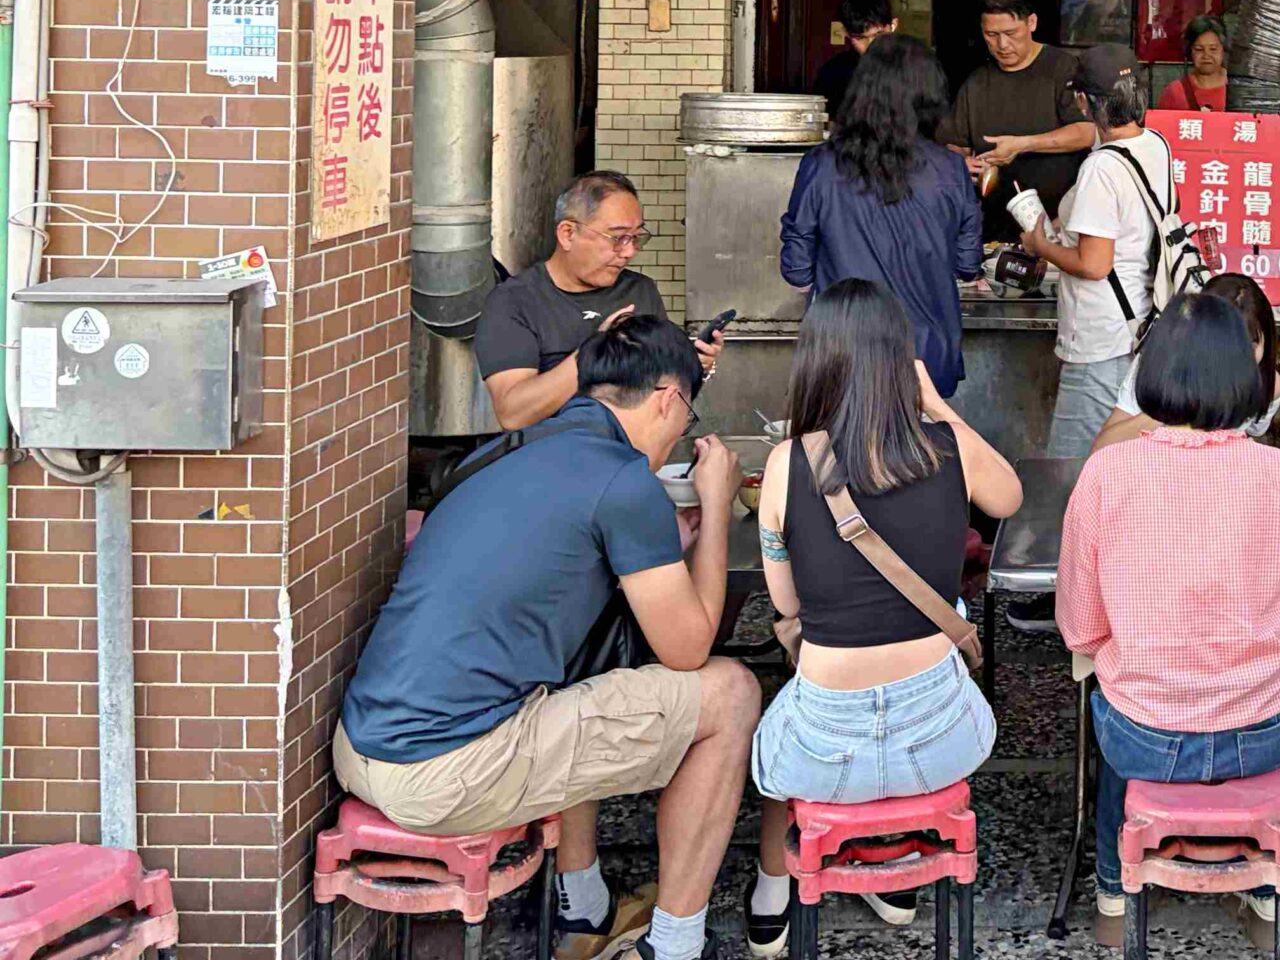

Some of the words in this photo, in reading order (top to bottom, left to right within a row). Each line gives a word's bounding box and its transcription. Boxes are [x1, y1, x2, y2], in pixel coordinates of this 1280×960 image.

[1242, 161, 1273, 245] 龍骨髓
[1241, 254, 1271, 277] 60
